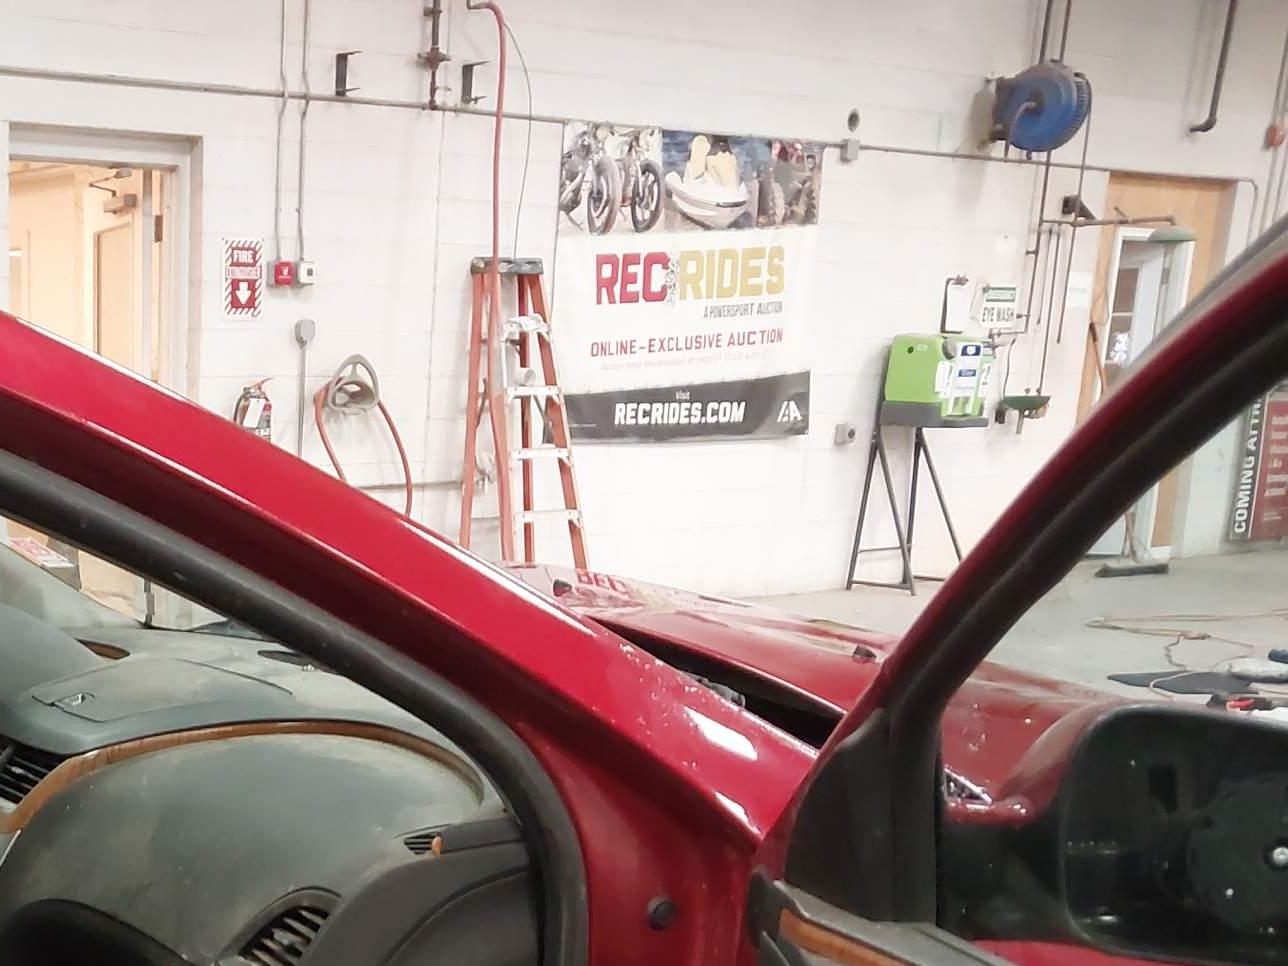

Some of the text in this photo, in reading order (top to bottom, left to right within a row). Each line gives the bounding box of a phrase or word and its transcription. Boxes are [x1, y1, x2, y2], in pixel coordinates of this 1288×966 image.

[233, 250, 254, 263] FIRE
[596, 247, 785, 305] REC RIDES
[703, 301, 783, 319] A POWERSPORT AUCTION
[982, 307, 1015, 322] EYE WASH
[590, 328, 783, 357] ONLINE-EXCLUSIVE AUCTION
[614, 401, 746, 425] RECRIDES.COM
[1234, 456, 1255, 533] COMING
